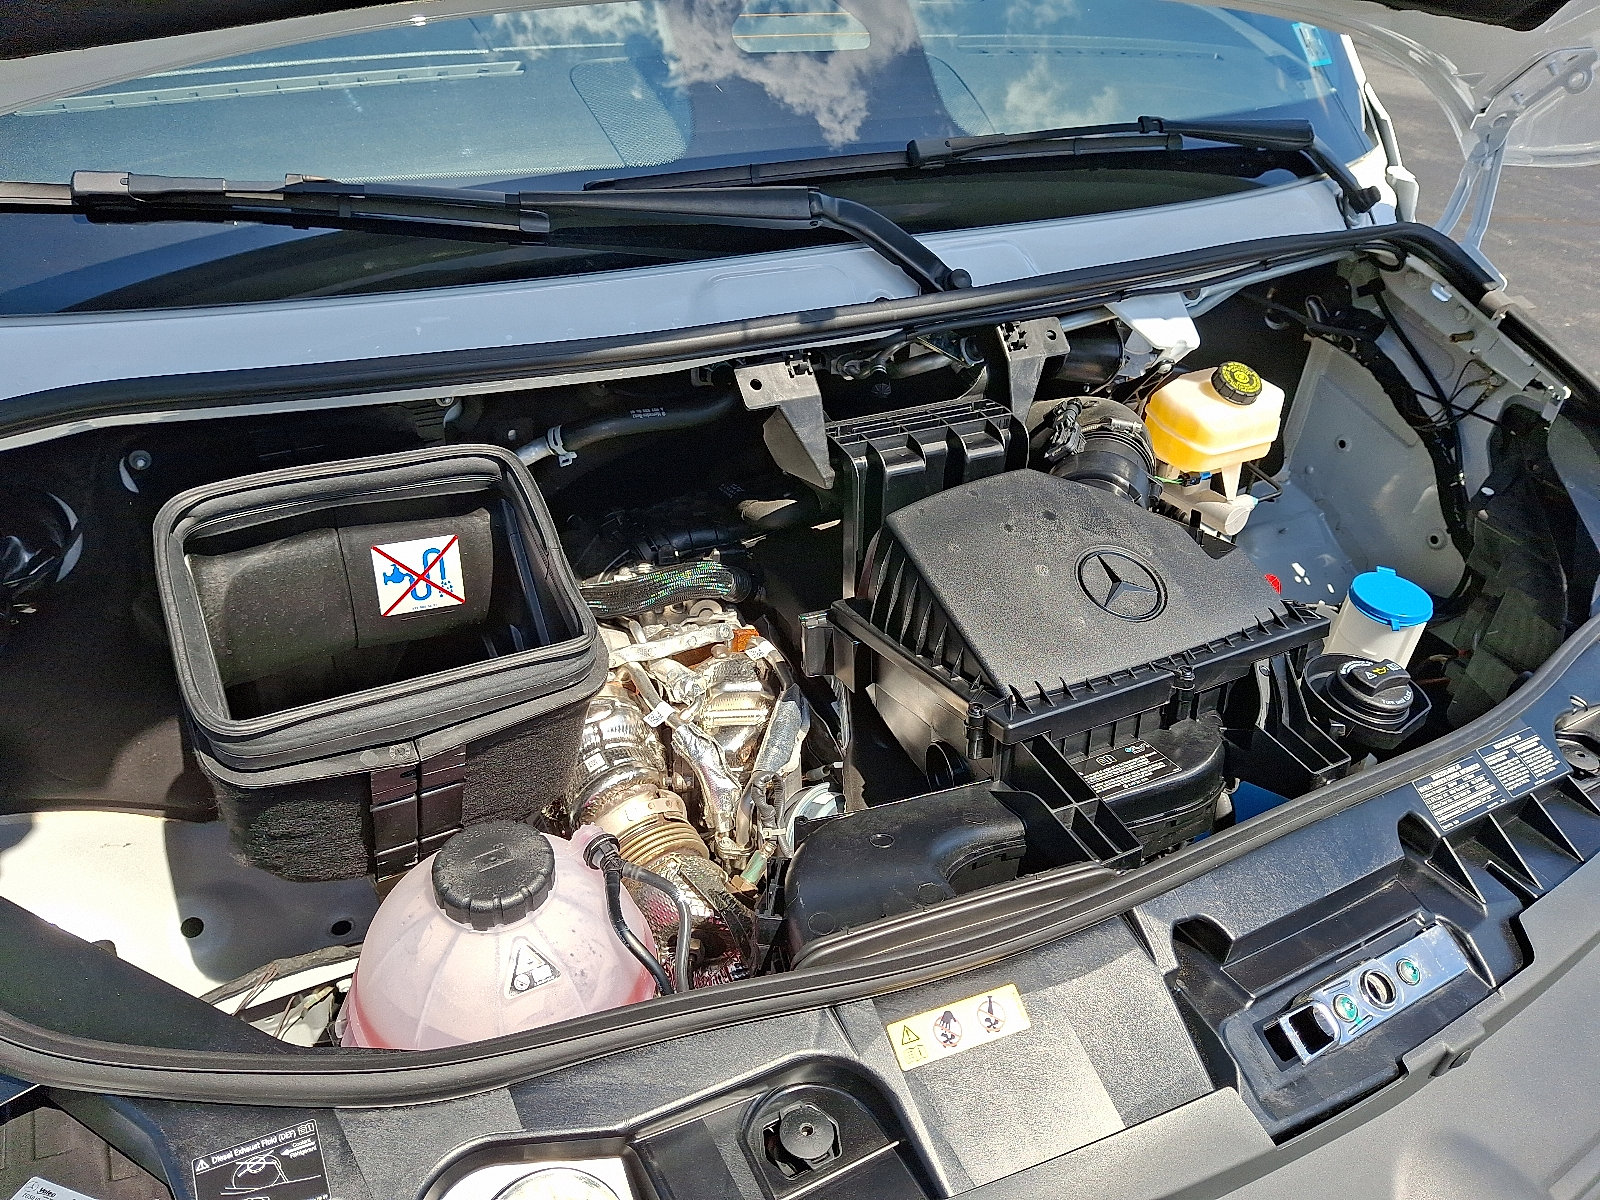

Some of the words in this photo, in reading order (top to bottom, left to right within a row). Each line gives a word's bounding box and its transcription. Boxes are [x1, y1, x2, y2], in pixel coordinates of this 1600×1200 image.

[211, 1150, 233, 1164] Diesel
[233, 1142, 260, 1156] Exhaust
[261, 1136, 278, 1148] Fluid
[278, 1129, 297, 1142] (DEF)
